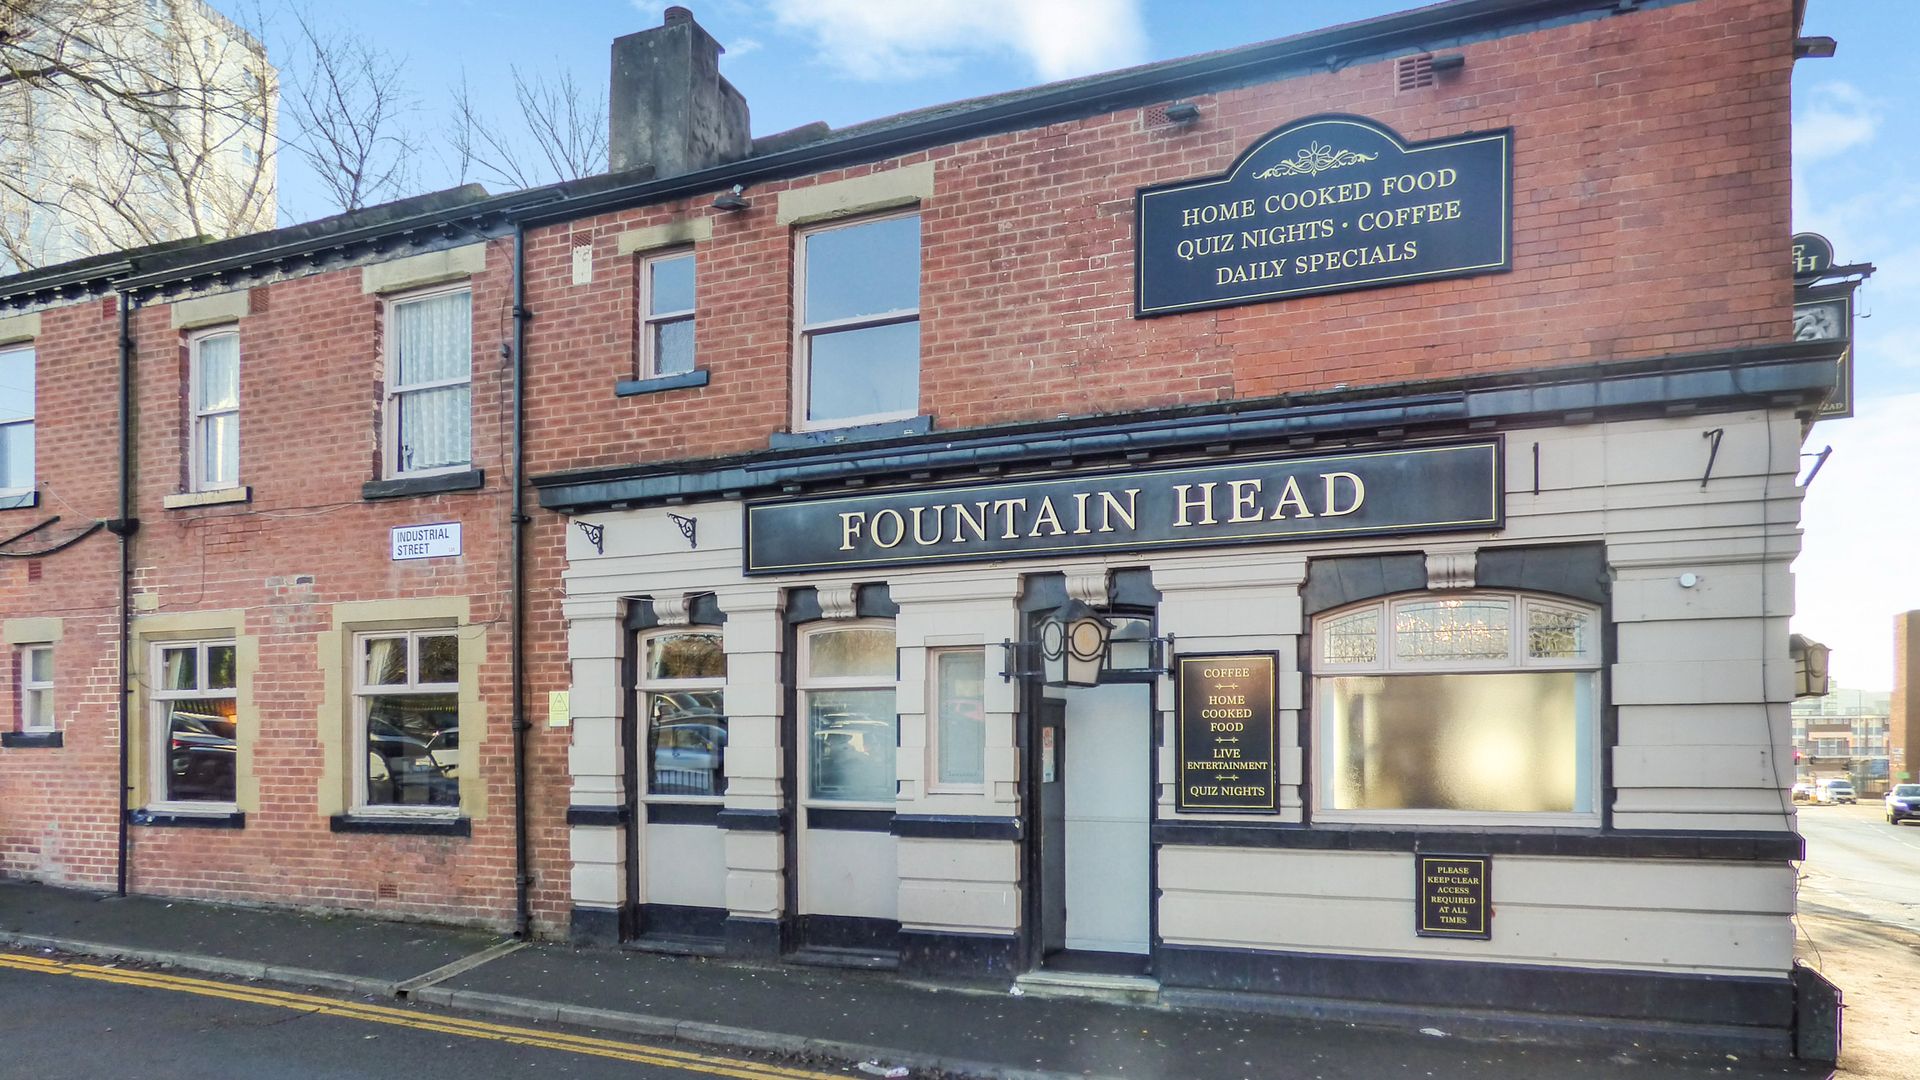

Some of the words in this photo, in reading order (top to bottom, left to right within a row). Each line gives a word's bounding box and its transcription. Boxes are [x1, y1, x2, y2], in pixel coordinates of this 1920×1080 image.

[1182, 198, 1256, 228] HOME
[1264, 180, 1371, 215] COOKED
[1382, 167, 1457, 197] FOOD
[1177, 235, 1234, 261] QUIZ
[1241, 219, 1334, 250] NIGHTS
[1358, 200, 1461, 233] COFFEE
[1216, 258, 1287, 286] DAILY
[1295, 241, 1418, 275] SPECIALS
[839, 489, 1140, 550] FOUNTAIN
[1172, 471, 1366, 528] HEAD
[397, 528, 449, 542] INDUSTRIAL
[397, 543, 430, 556] STREET
[1204, 668, 1250, 678] COFFEE
[1209, 695, 1245, 705] HOME
[1202, 709, 1252, 719] COOKED
[1210, 722, 1244, 732] FOOD
[1213, 748, 1241, 758] LIVE
[1187, 761, 1268, 770] ENTERTAINMENT
[1190, 786, 1218, 797] QUIZ
[1221, 786, 1265, 796] NIGHTS
[1437, 866, 1469, 874] PLEASE
[1427, 876, 1450, 884] KEEP
[1451, 877, 1479, 885] CLEAR
[1437, 886, 1469, 894] ACCESS
[1431, 896, 1476, 905] REQUIRED
[1439, 906, 1449, 914] AT
[1451, 906, 1468, 914] ALL
[1440, 916, 1467, 924] TIMES
